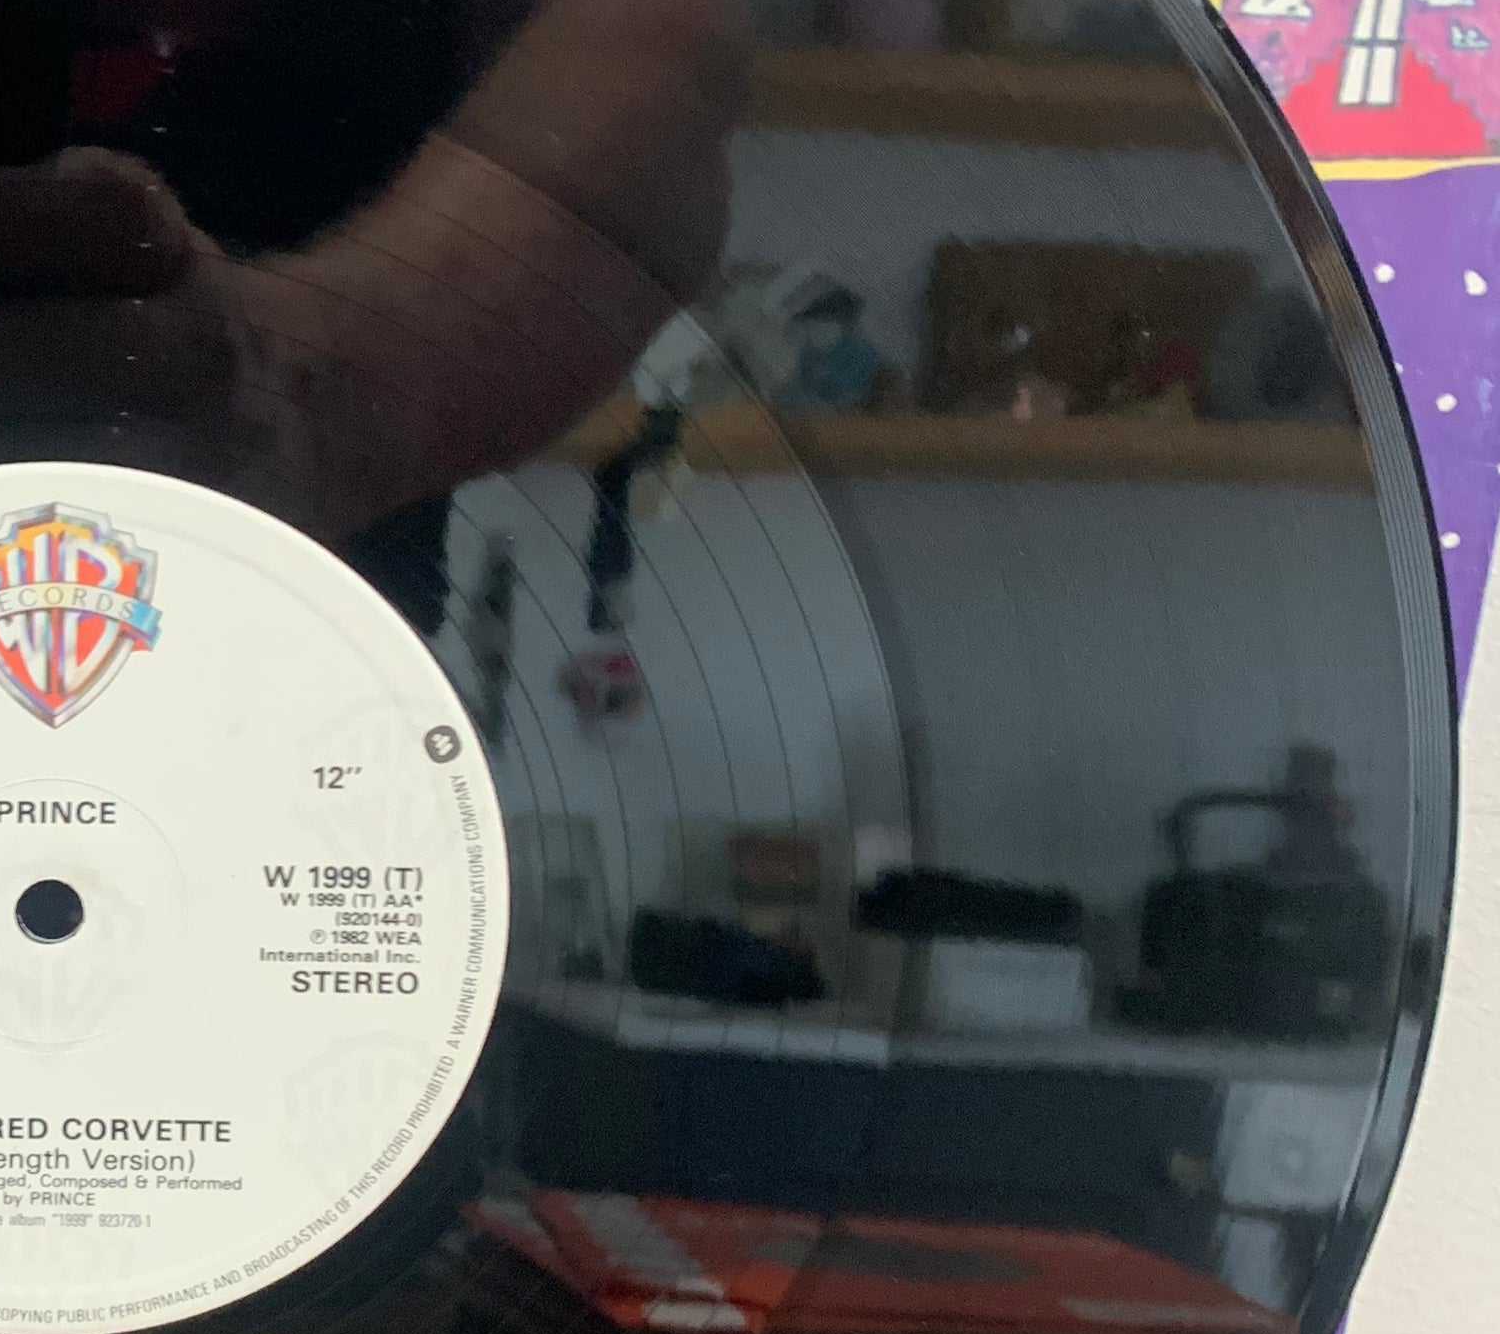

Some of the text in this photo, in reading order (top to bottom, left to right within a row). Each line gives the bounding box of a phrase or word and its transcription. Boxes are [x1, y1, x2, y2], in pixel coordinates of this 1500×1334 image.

[449, 774, 481, 841] COMPANY
[263, 865, 423, 892] W 1999 (T)
[280, 892, 300, 907] W
[308, 893, 345, 907] 1999
[352, 893, 377, 908] (T)
[465, 844, 487, 973] COMMUNICATIONS
[335, 911, 423, 928] (920144-0)
[331, 929, 369, 945] 1982
[376, 930, 422, 946] WEA
[259, 947, 421, 964] International Inc.
[290, 970, 420, 995] STEREO
[449, 977, 478, 1036] WARNER
[446, 1039, 461, 1051] A
[405, 1055, 455, 1136] PROHIBITED
[61, 1118, 232, 1143] CORVETTE
[82, 1147, 196, 1174] Version)
[372, 1129, 413, 1174] RECORD
[39, 1174, 128, 1191] Composed
[135, 1175, 148, 1189] &
[156, 1175, 243, 1191] Performed
[348, 1172, 377, 1200] THIS
[2, 1191, 96, 1208] by PRINCE
[334, 1196, 353, 1215] OF
[8, 1212, 46, 1227] album
[98, 1213, 151, 1229] 923720-1
[242, 1208, 339, 1278] BROADCASTING
[213, 1269, 242, 1290] AND
[110, 1282, 210, 1318] PERFORMANCE
[57, 1307, 105, 1322] PUBLIC
